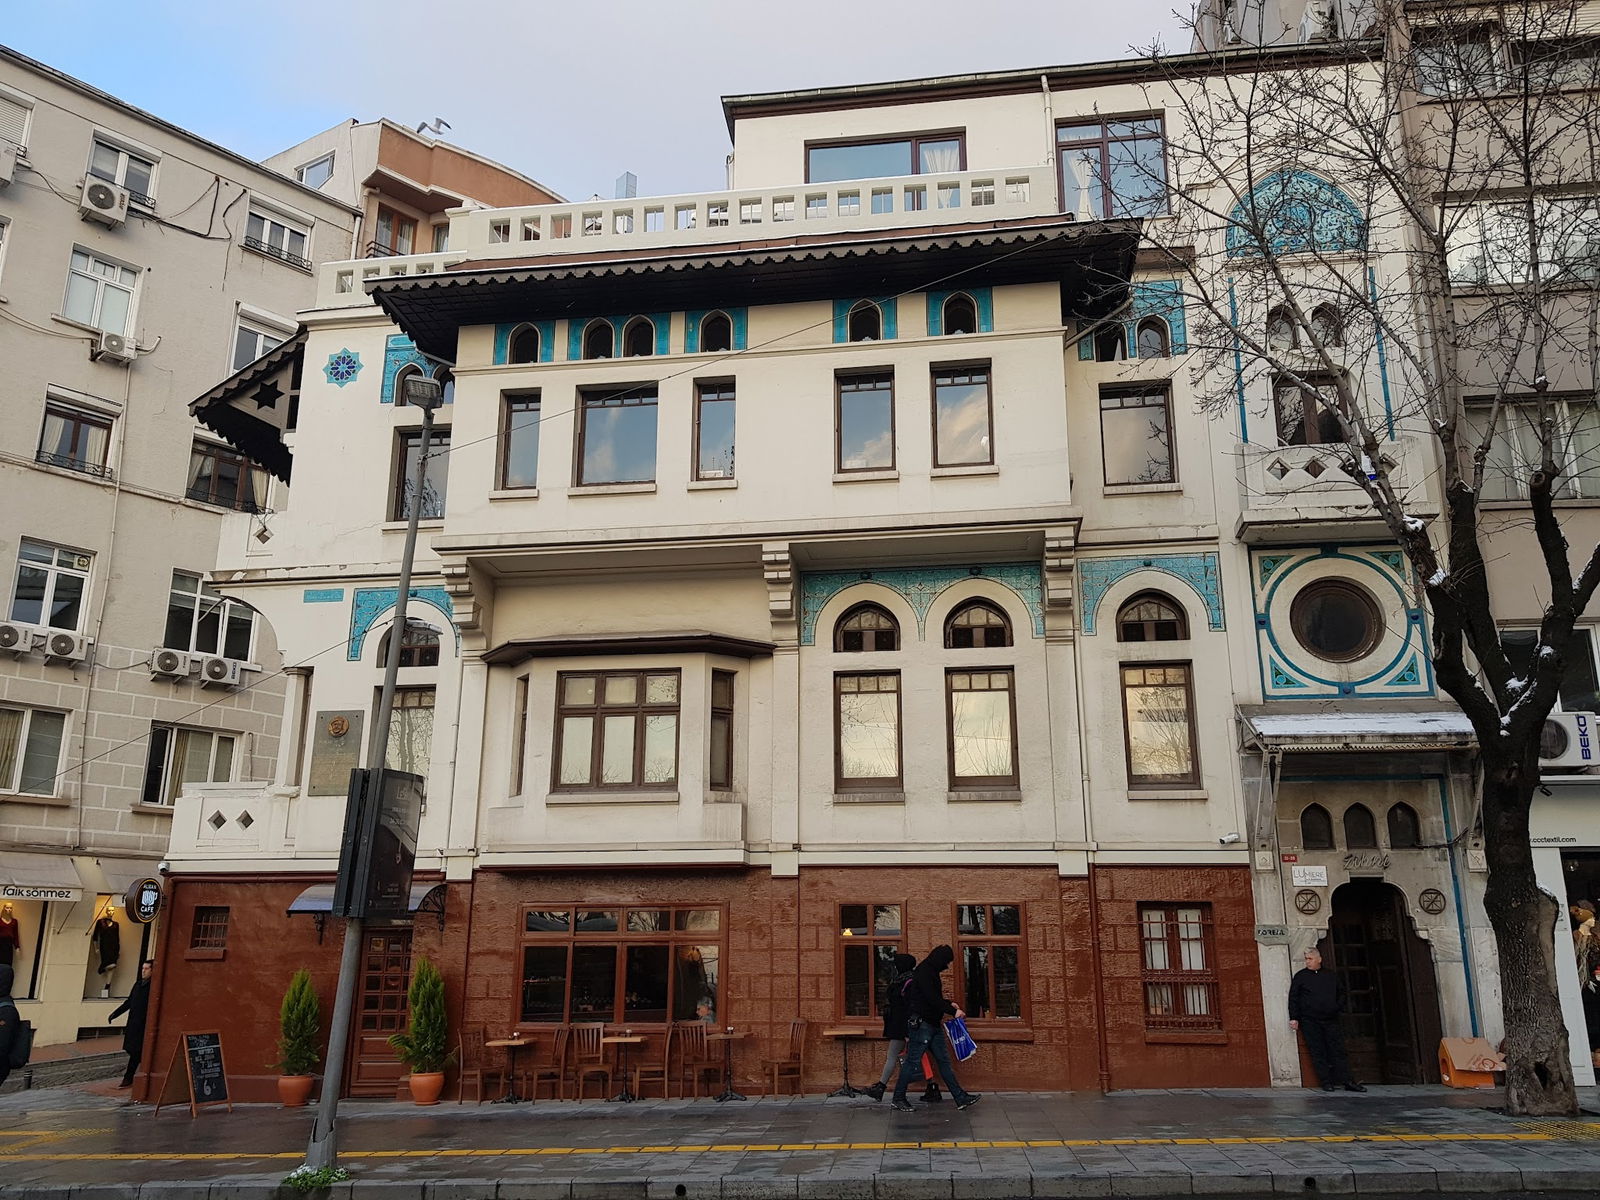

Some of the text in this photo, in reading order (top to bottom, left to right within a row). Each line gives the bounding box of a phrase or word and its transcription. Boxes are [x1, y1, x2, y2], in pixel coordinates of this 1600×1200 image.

[1574, 713, 1592, 760] BEKO
[26, 887, 71, 899] sönmez
[203, 1079, 212, 1096] 6
